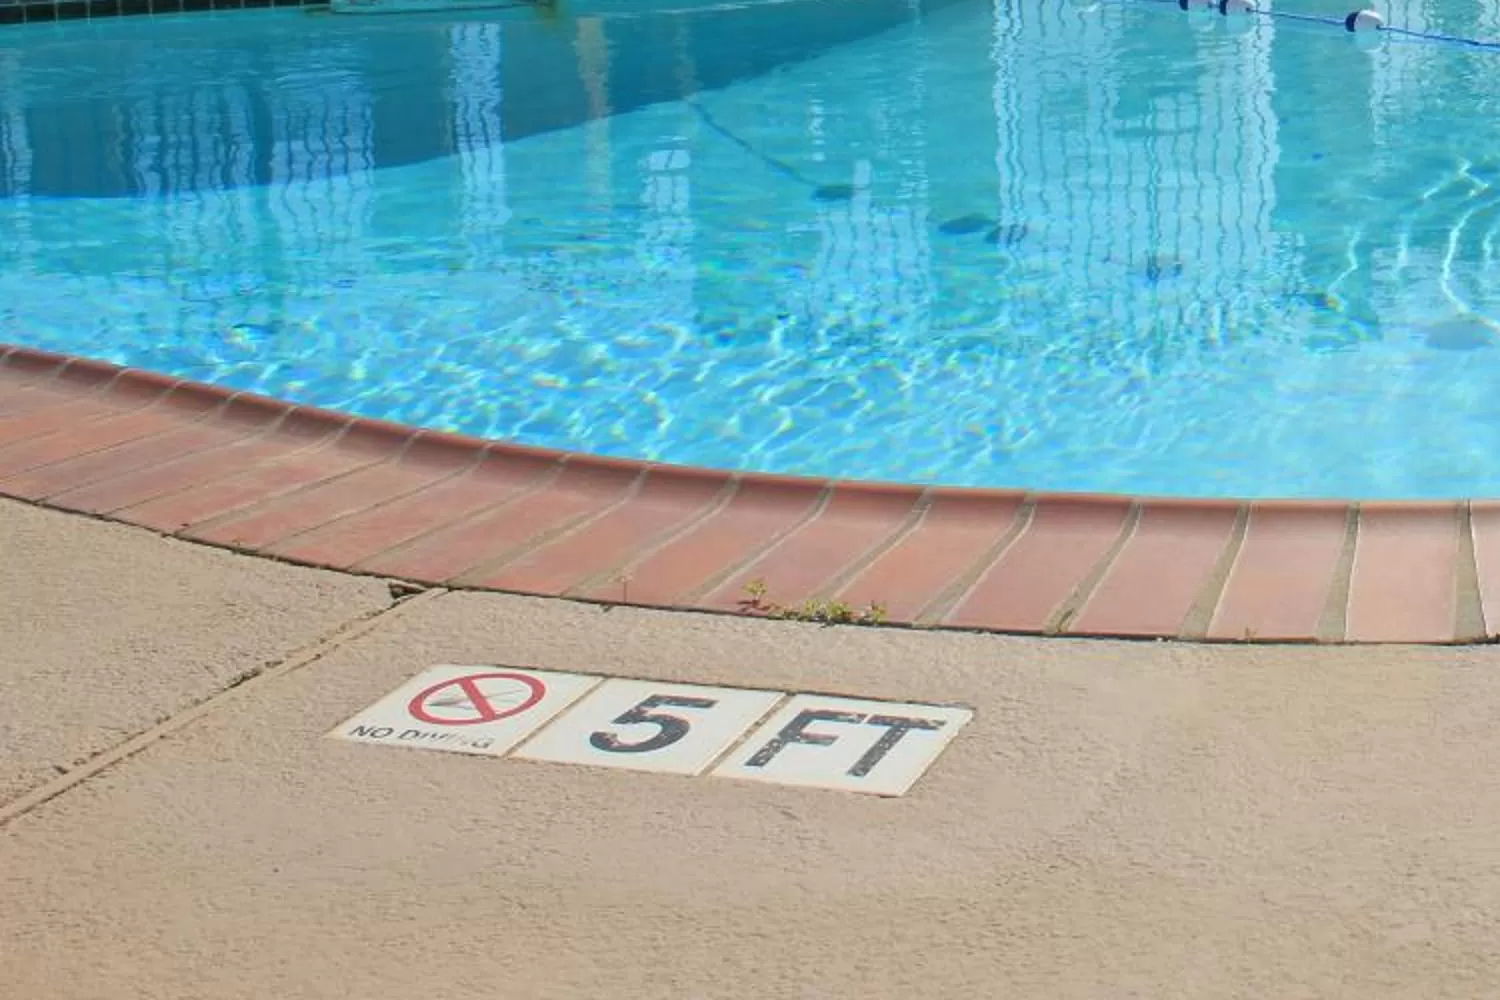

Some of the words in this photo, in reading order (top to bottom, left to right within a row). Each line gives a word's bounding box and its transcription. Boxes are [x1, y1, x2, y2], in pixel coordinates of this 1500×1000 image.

[350, 726, 394, 739] NO
[398, 729, 494, 748] DIVG
[588, 694, 718, 754] 5
[744, 709, 946, 778] FT
